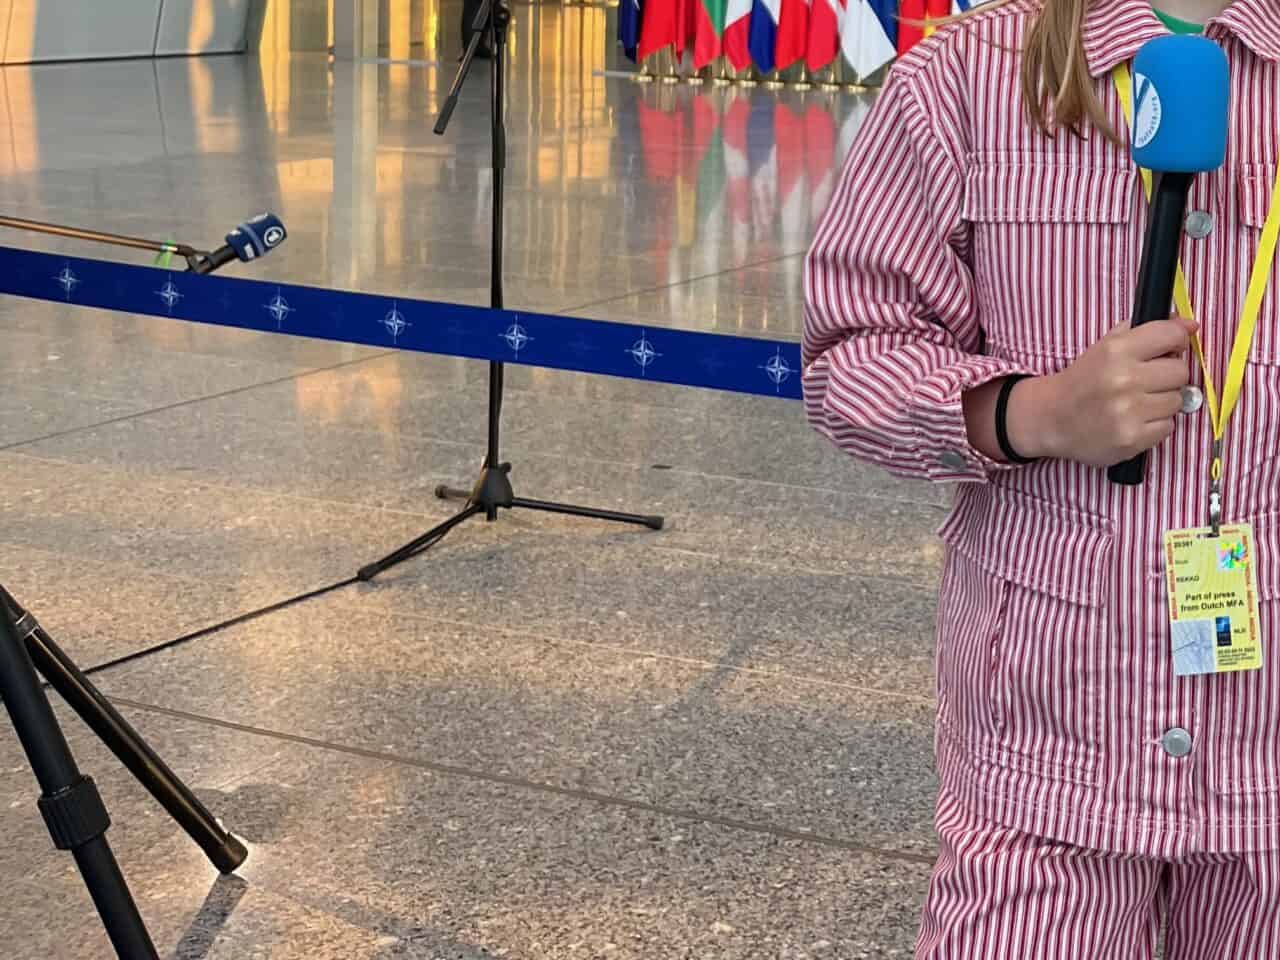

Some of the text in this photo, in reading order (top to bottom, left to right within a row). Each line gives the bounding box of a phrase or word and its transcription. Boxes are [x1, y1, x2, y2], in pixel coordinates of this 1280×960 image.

[1185, 591, 1236, 601] Part of press
[1180, 599, 1245, 613] from Dutch MFA
